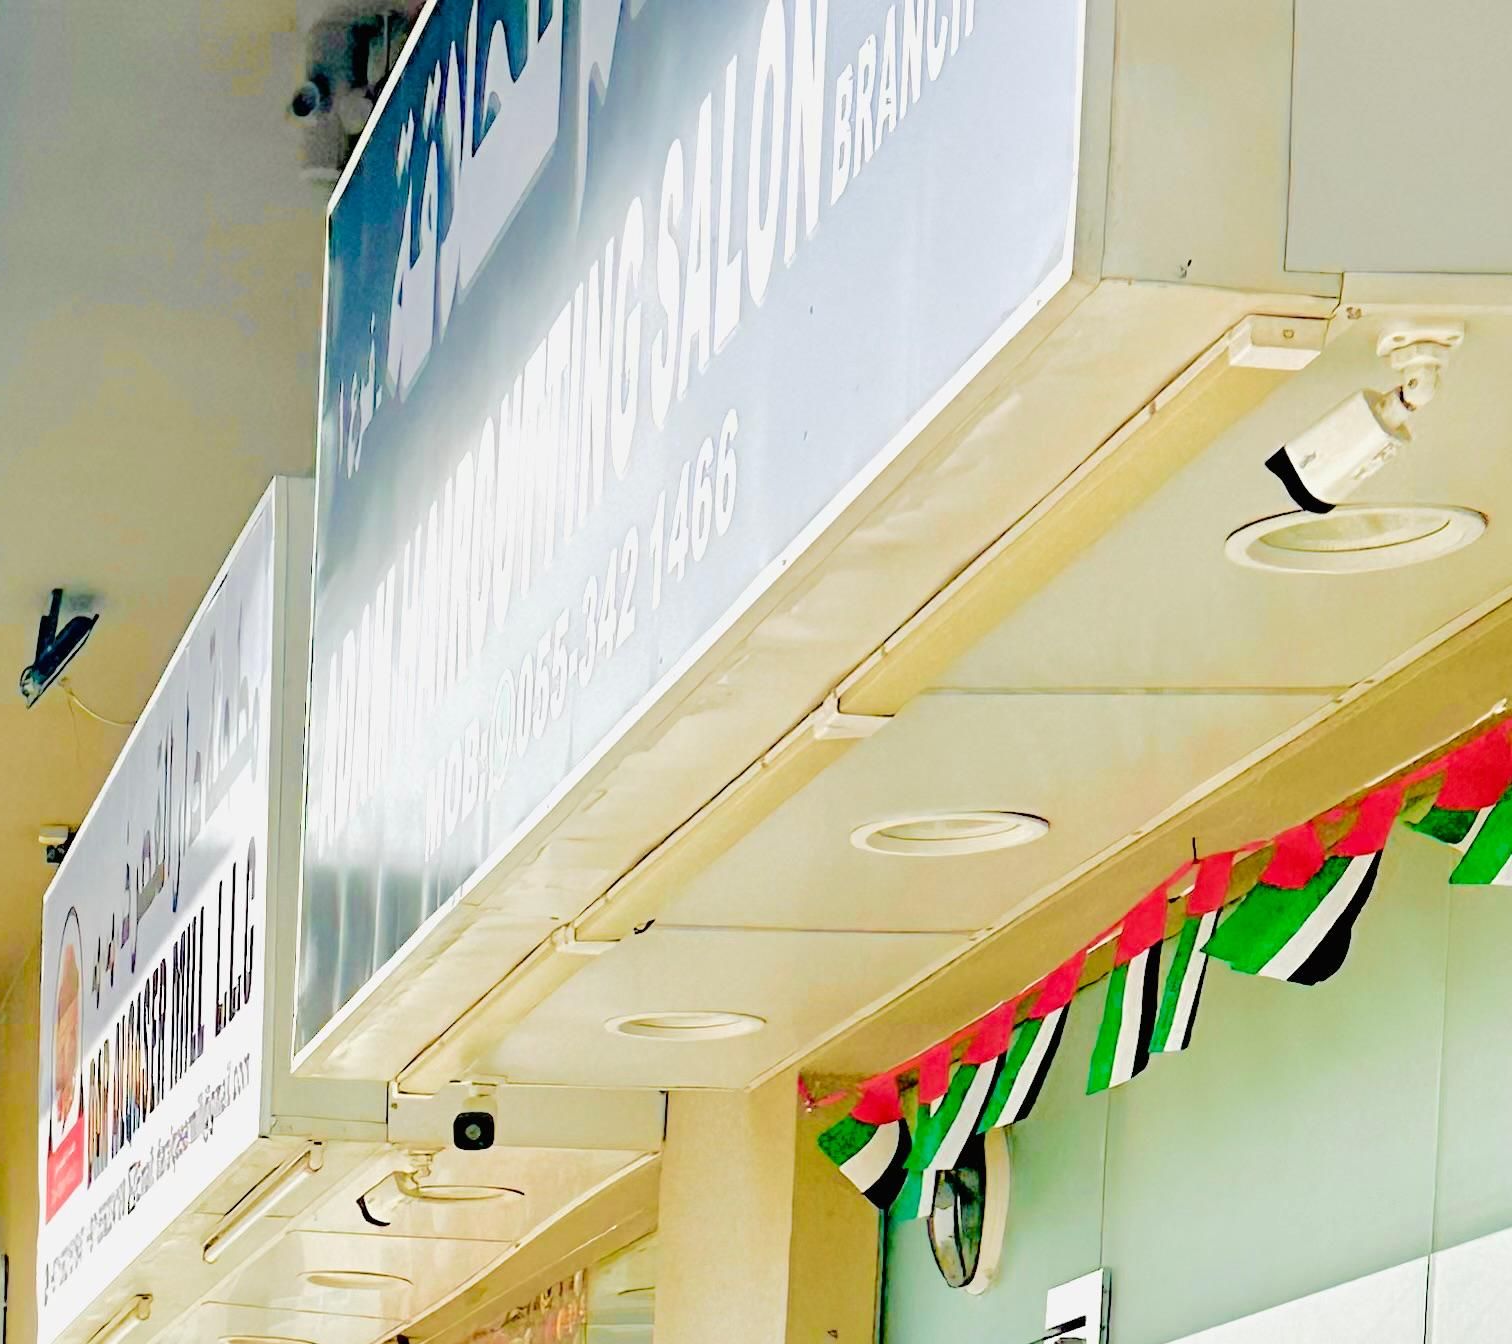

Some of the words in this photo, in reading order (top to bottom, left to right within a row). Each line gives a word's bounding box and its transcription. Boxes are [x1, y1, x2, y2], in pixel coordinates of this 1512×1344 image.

[650, 0, 828, 432] SALON
[515, 525, 639, 757] 055-342
[650, 408, 738, 610] 1466
[170, 905, 206, 1091] MILL
